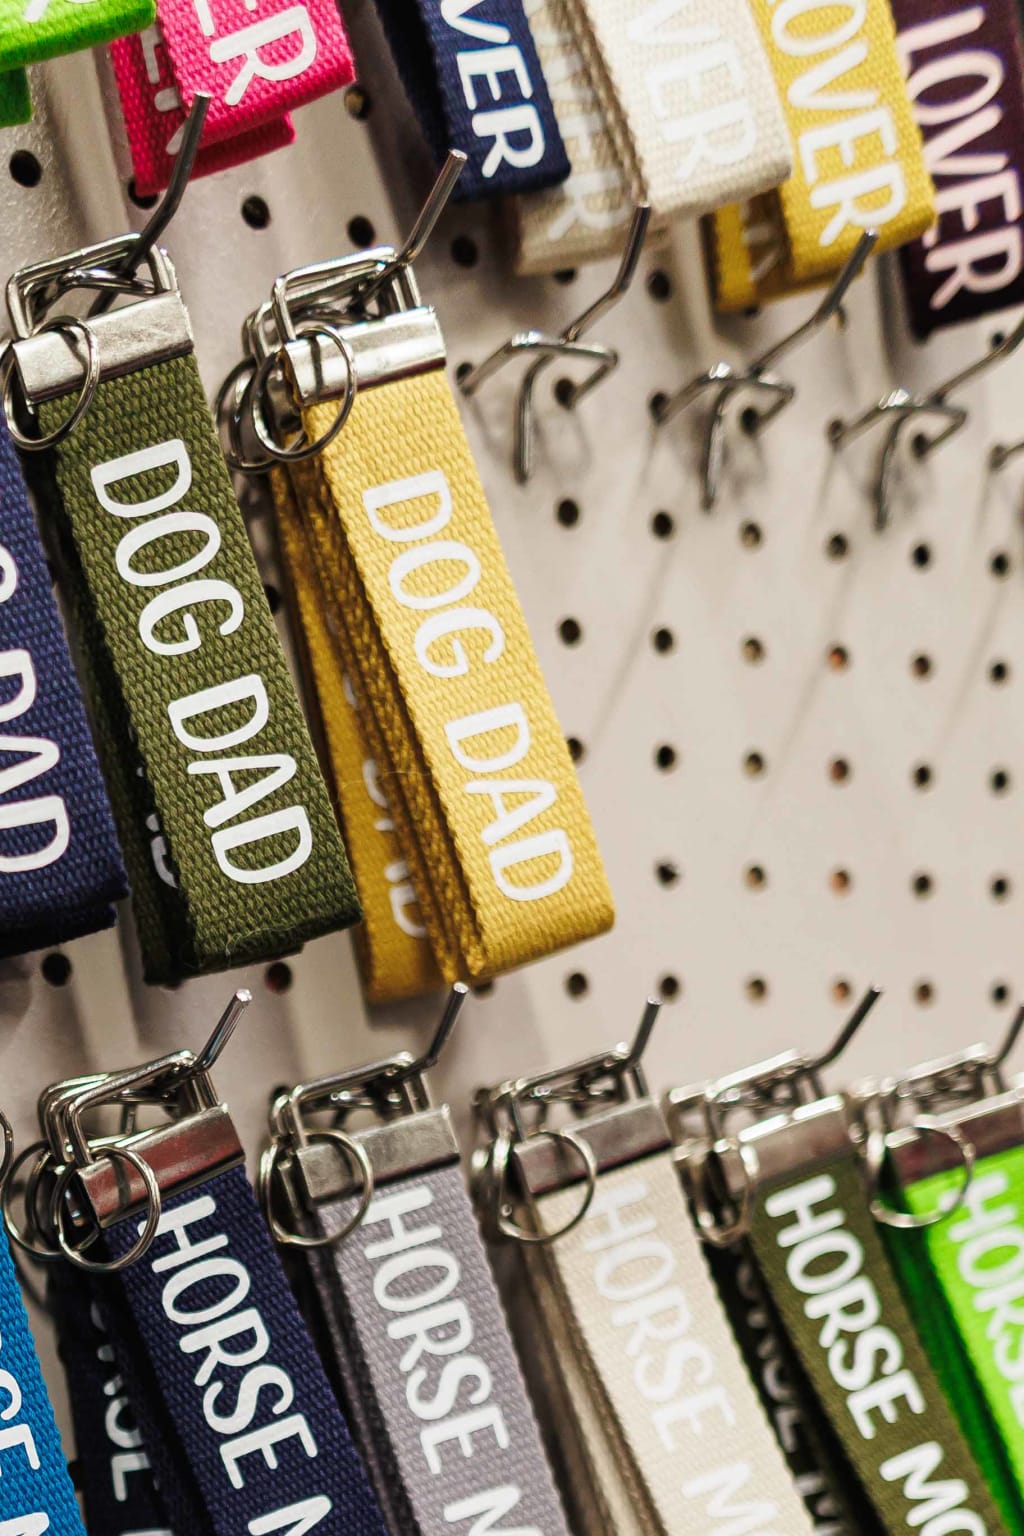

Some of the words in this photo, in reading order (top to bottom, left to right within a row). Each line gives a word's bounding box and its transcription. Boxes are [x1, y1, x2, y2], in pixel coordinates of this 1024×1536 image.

[90, 438, 245, 656] DOG
[167, 673, 315, 884] DAD
[361, 469, 507, 679] DOG
[445, 701, 576, 903] DAD
[139, 1195, 319, 1490] HORSE
[361, 1186, 511, 1475] HORSE
[578, 1181, 737, 1453] HORSE
[764, 1174, 926, 1440] HORSE
